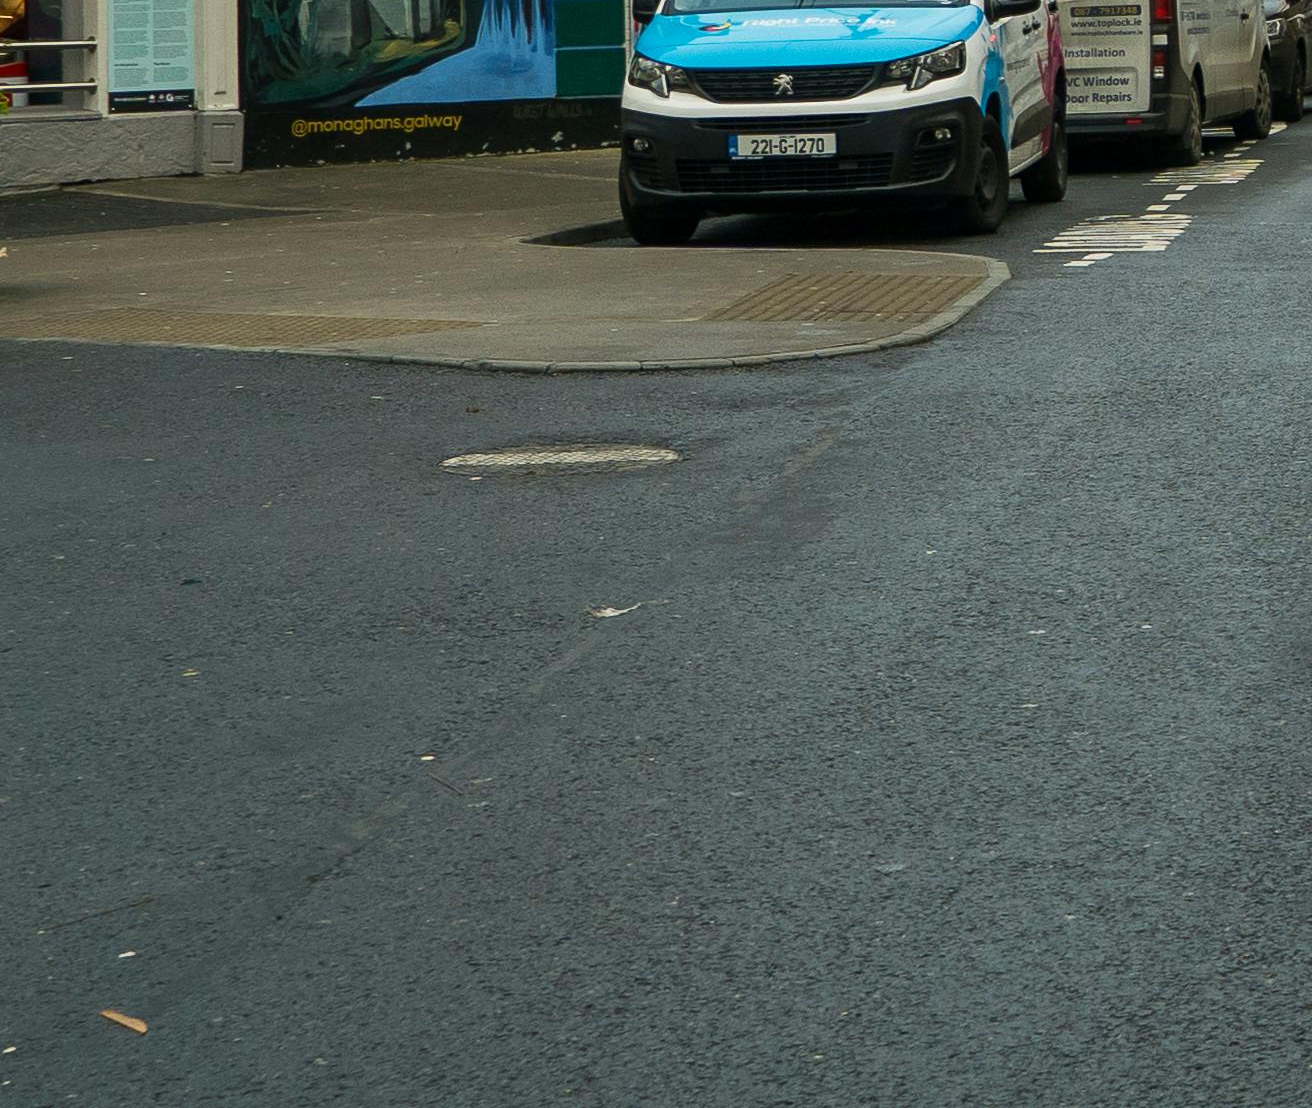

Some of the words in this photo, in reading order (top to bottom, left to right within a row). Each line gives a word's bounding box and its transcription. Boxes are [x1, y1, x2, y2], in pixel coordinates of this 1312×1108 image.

[742, 17, 800, 28] Right
[804, 16, 860, 26] Price
[1064, 48, 1126, 58] Installation
[1083, 75, 1130, 87] Window
[1092, 92, 1132, 104] Repairs
[291, 114, 462, 137] @monaghans.galway
[751, 137, 826, 155] 221-G-1270
